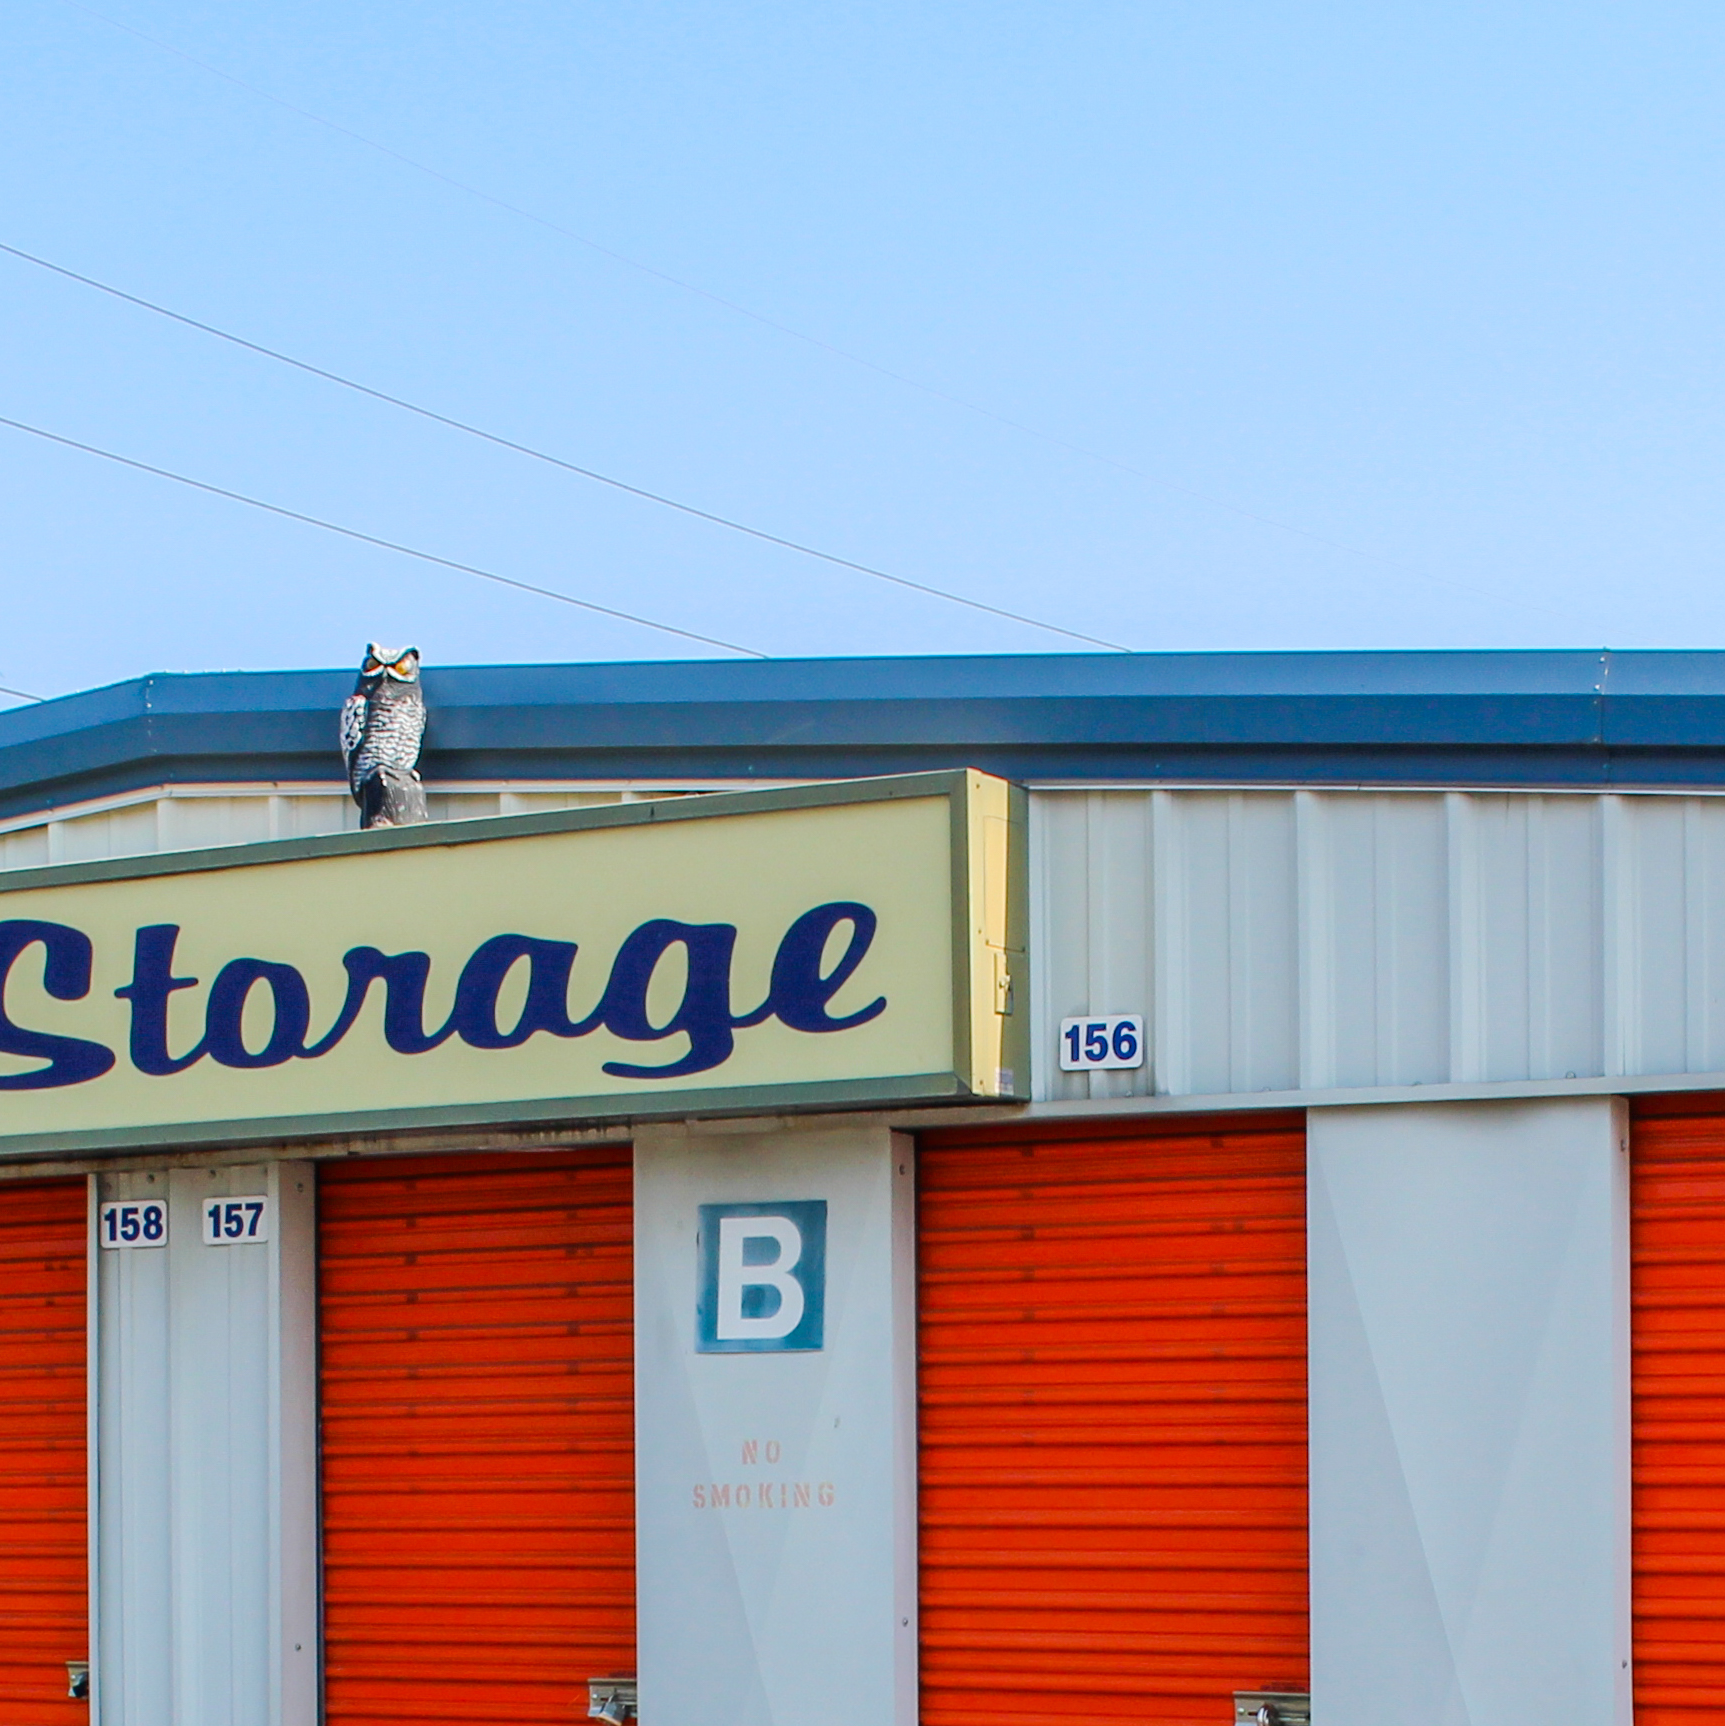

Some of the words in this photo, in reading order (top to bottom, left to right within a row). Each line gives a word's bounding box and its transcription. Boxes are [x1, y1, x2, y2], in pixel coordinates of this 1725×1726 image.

[1065, 1021, 1137, 1062] 156
[104, 1206, 163, 1241] 158
[208, 1203, 264, 1238] 157
[717, 1216, 804, 1340] B
[741, 1440, 781, 1465] NO
[692, 1483, 836, 1508] SMOKING
